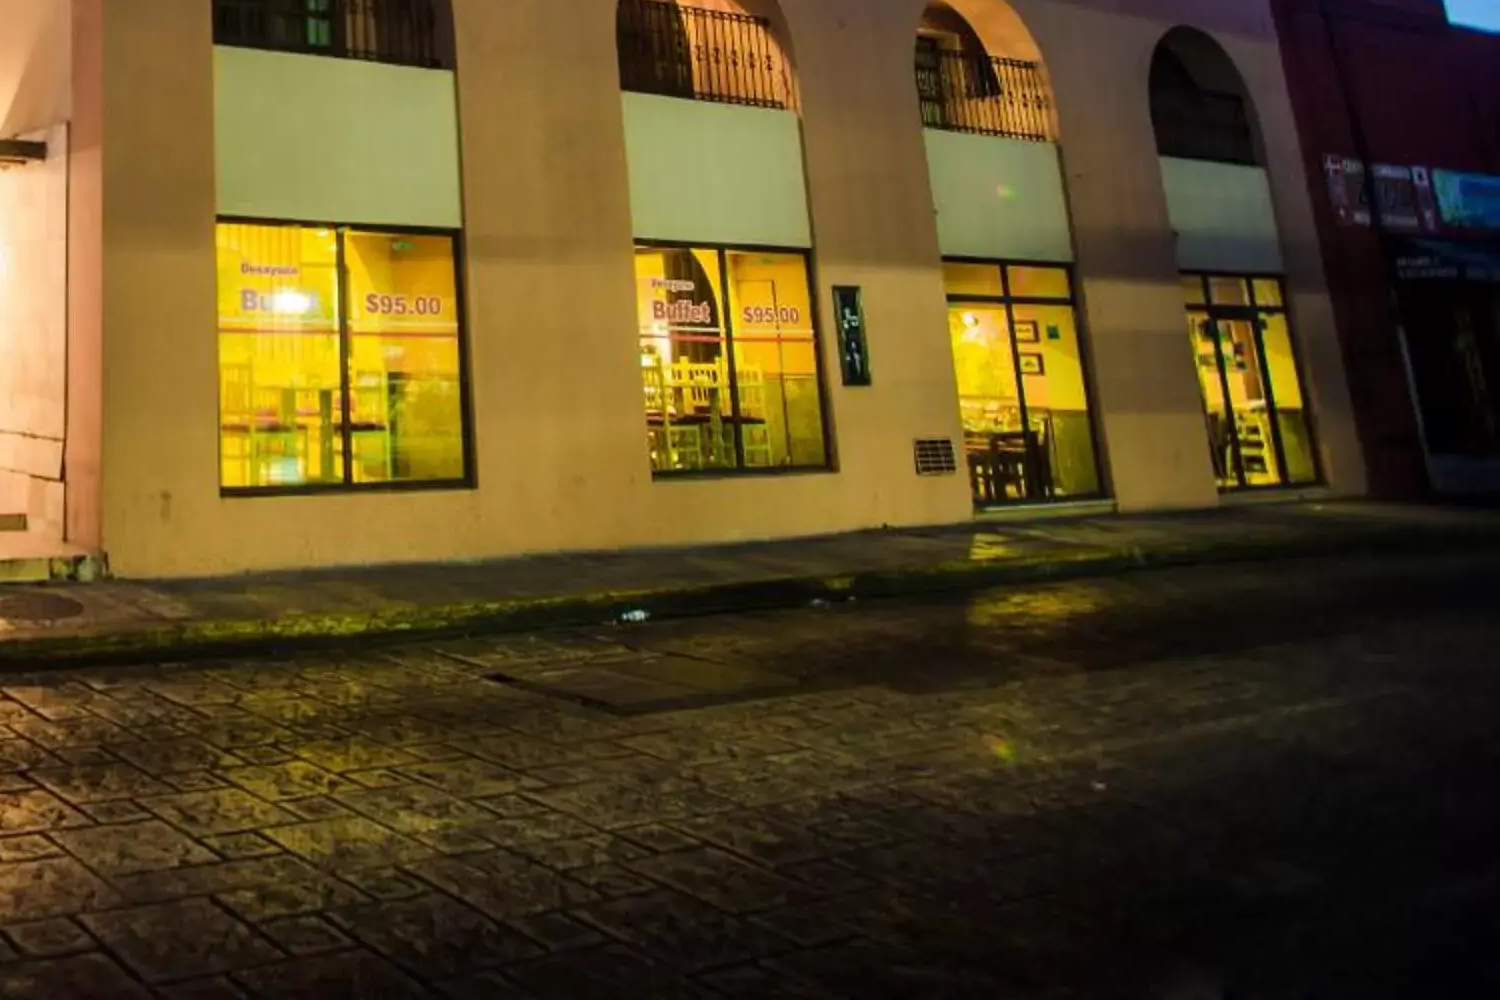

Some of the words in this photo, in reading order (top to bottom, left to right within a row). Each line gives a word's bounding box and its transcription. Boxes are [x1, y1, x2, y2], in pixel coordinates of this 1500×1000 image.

[366, 291, 442, 316] $95.00
[653, 300, 711, 324] Buffet
[743, 306, 800, 324] $95.00
